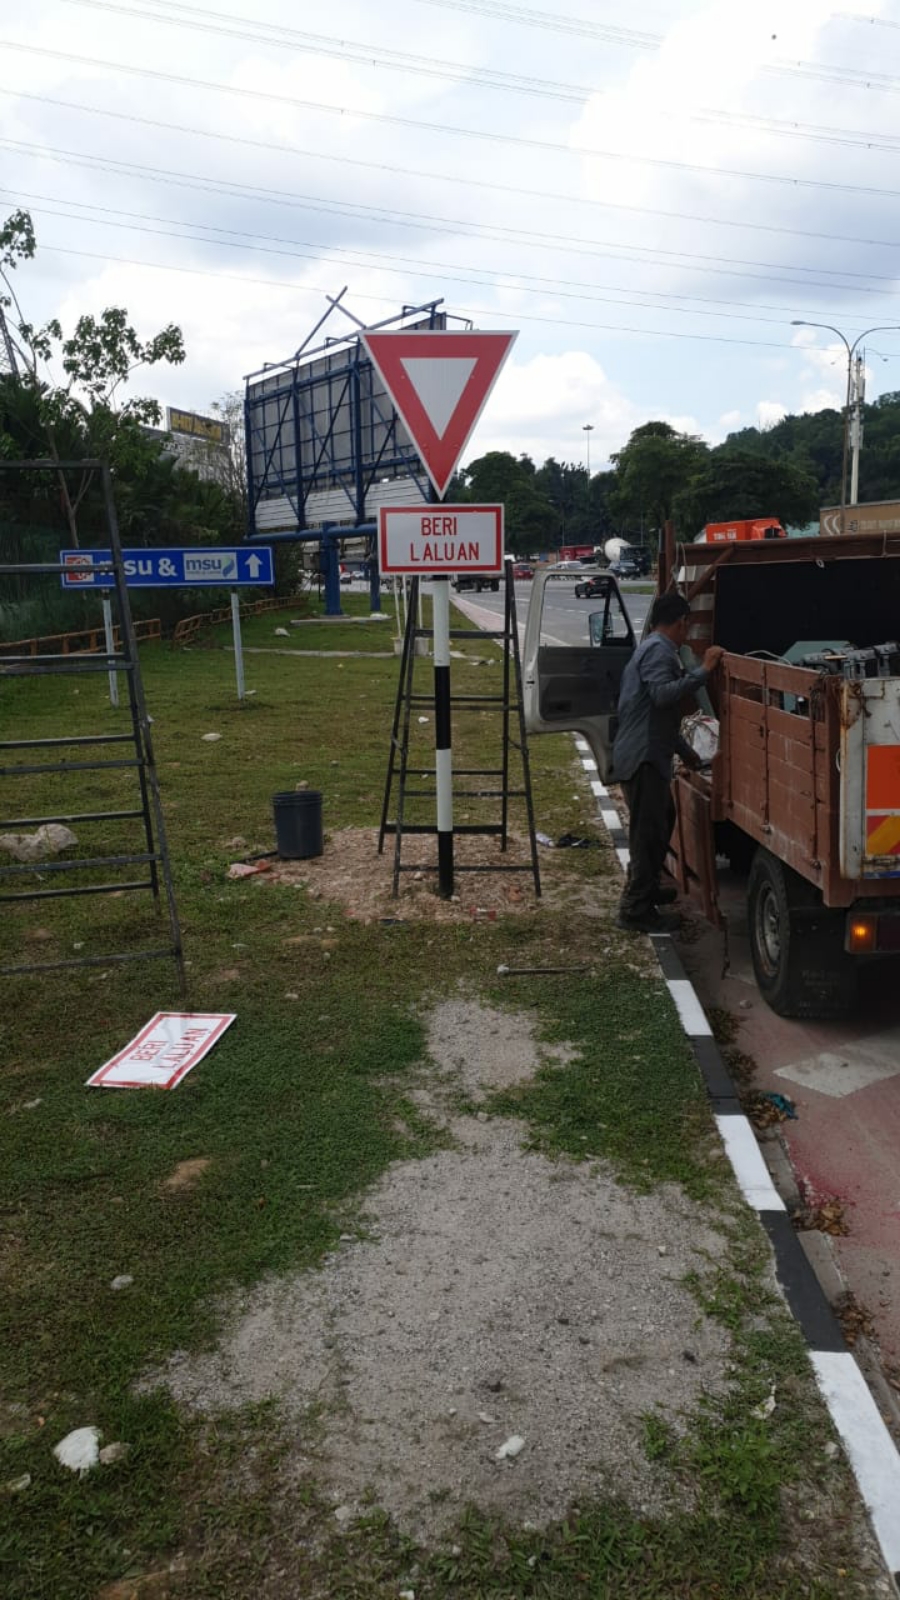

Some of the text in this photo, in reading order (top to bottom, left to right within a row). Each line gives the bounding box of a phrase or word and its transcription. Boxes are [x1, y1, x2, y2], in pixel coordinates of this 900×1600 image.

[421, 517, 457, 536] BERI
[410, 541, 480, 561] LALUAN
[158, 557, 178, 577] &
[186, 558, 222, 570] msu
[129, 1040, 169, 1061] BERI
[151, 1028, 209, 1069] LALUAN
